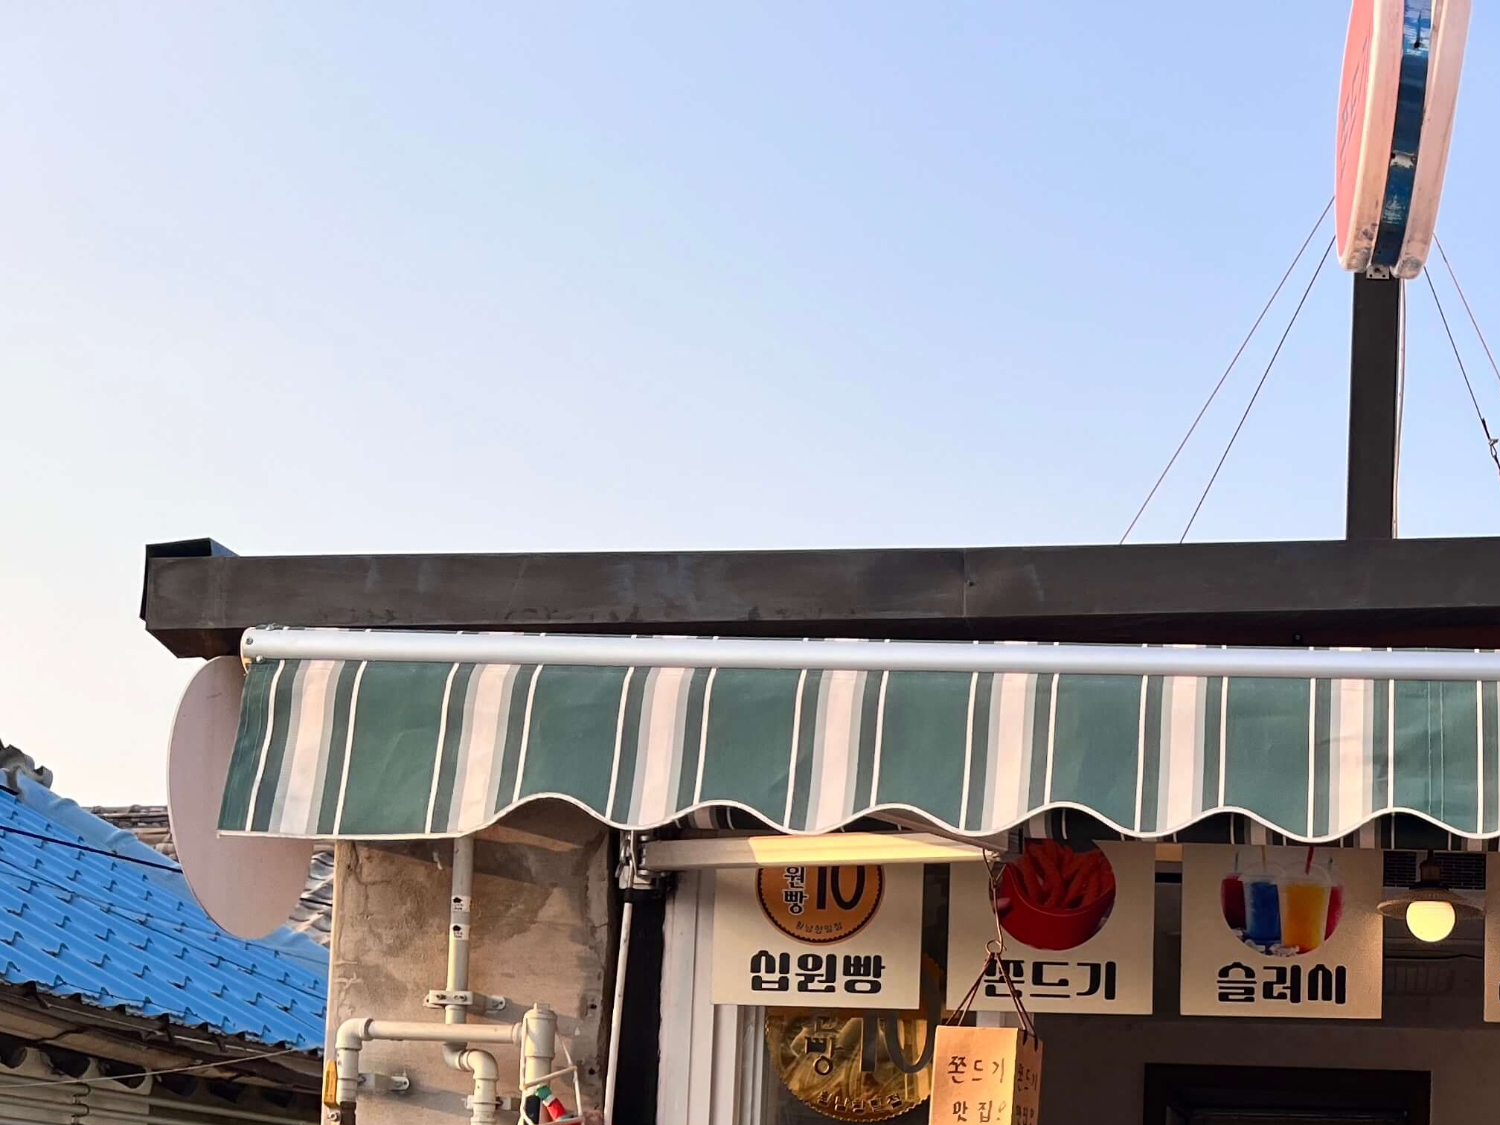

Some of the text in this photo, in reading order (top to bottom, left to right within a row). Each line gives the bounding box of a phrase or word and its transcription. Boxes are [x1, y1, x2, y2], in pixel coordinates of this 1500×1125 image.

[749, 950, 886, 994] 십원빵
[983, 959, 1117, 1000] 쫀드기
[1216, 961, 1347, 1004] 슬러시
[947, 1055, 1005, 1084] 쫀드기
